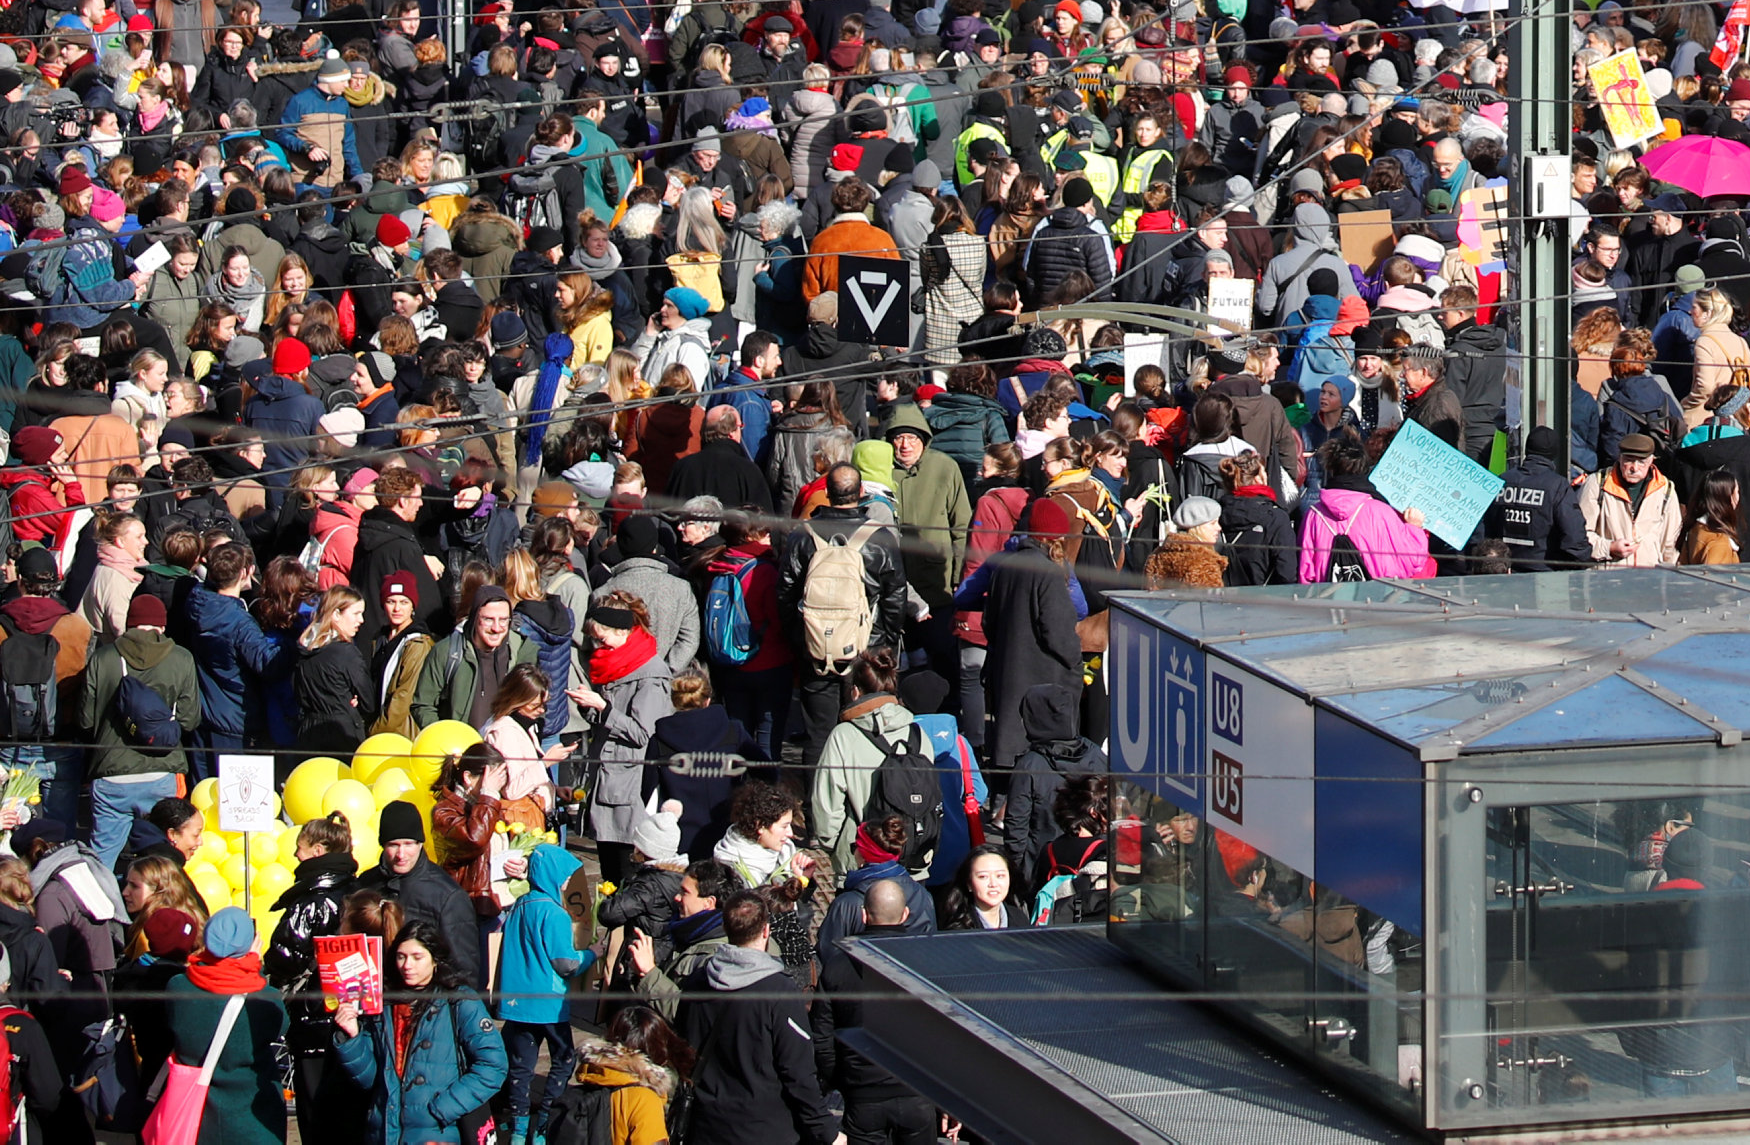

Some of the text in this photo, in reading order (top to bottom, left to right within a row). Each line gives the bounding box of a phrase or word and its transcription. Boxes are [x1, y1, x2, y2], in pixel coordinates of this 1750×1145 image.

[1212, 297, 1250, 307] FUTURE
[1495, 486, 1545, 506] POLIZEI
[1117, 622, 1150, 772] U
[1215, 680, 1241, 737] U8
[1215, 758, 1241, 815] U5
[315, 937, 362, 955] FIGHT
